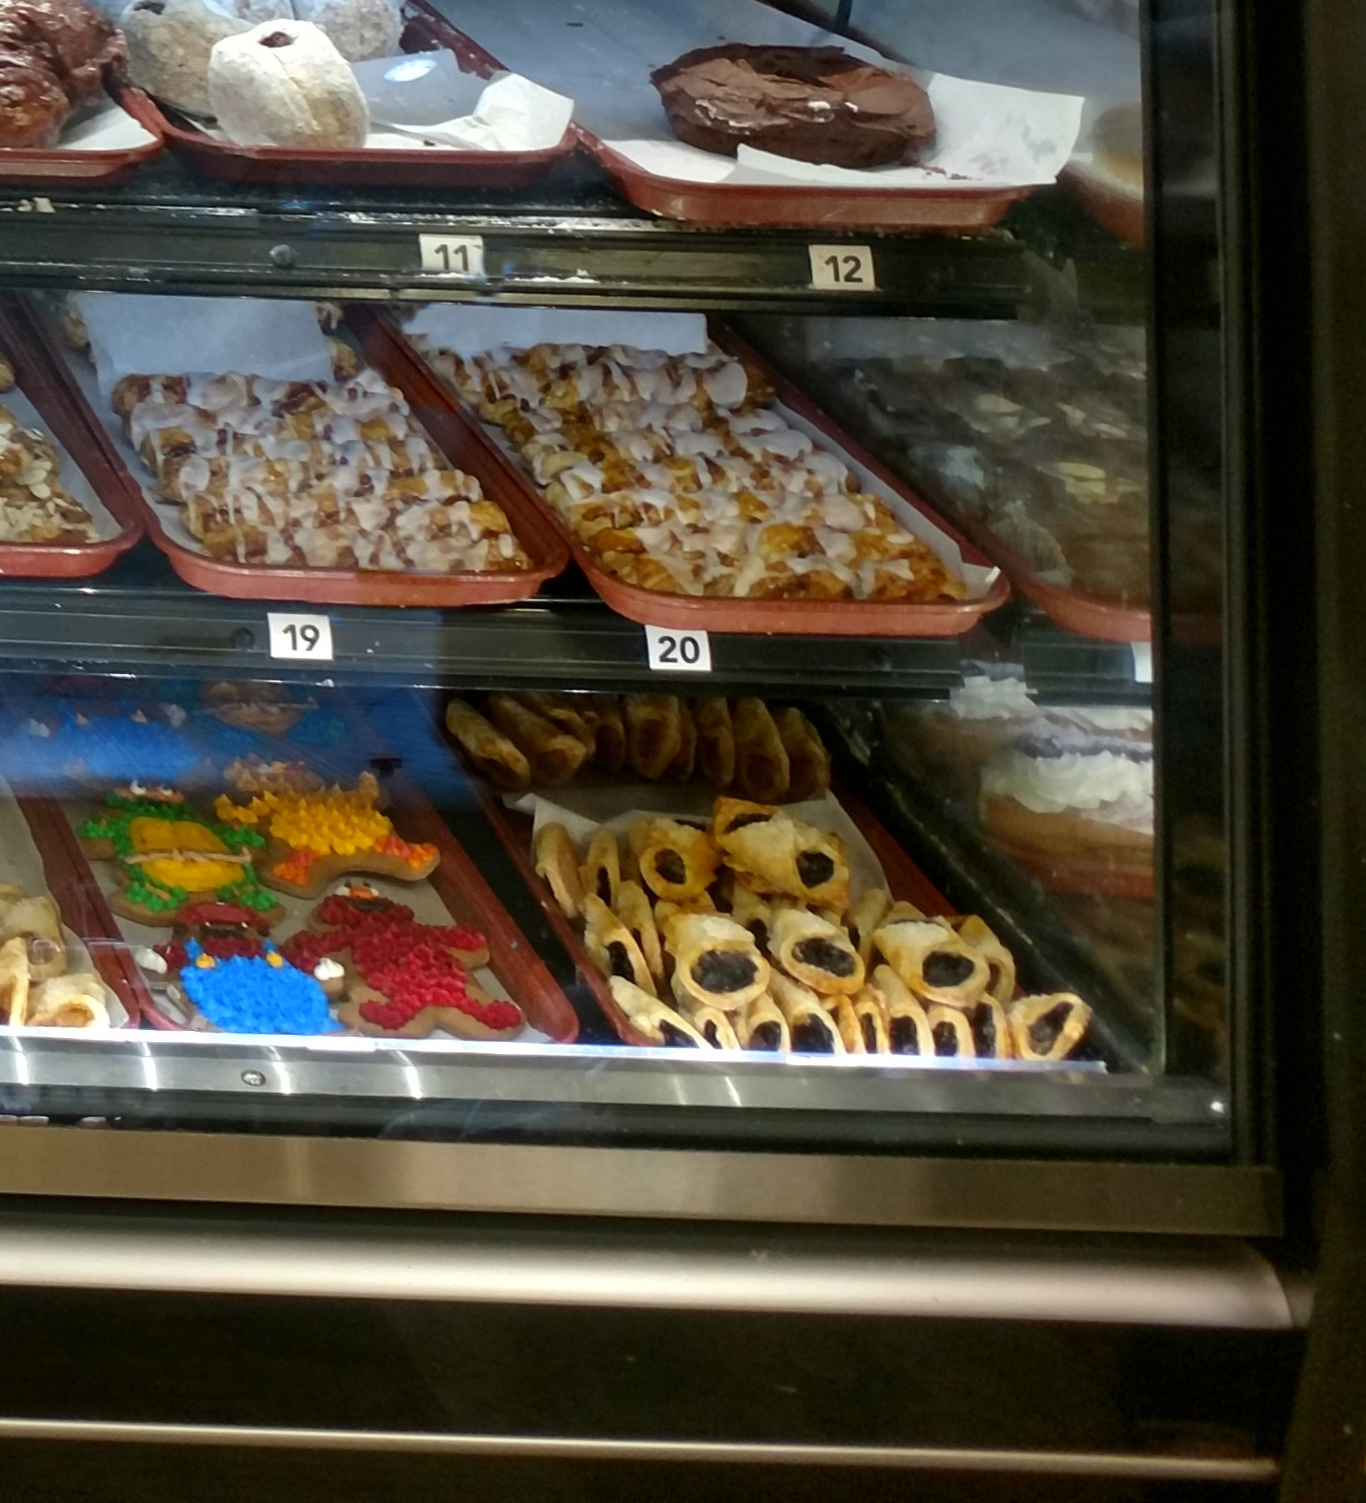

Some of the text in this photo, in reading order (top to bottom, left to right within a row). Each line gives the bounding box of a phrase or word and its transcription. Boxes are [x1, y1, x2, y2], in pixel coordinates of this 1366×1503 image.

[435, 244, 469, 273] 11
[825, 256, 864, 283] 12
[283, 625, 320, 652] 19
[659, 636, 700, 664] 20
